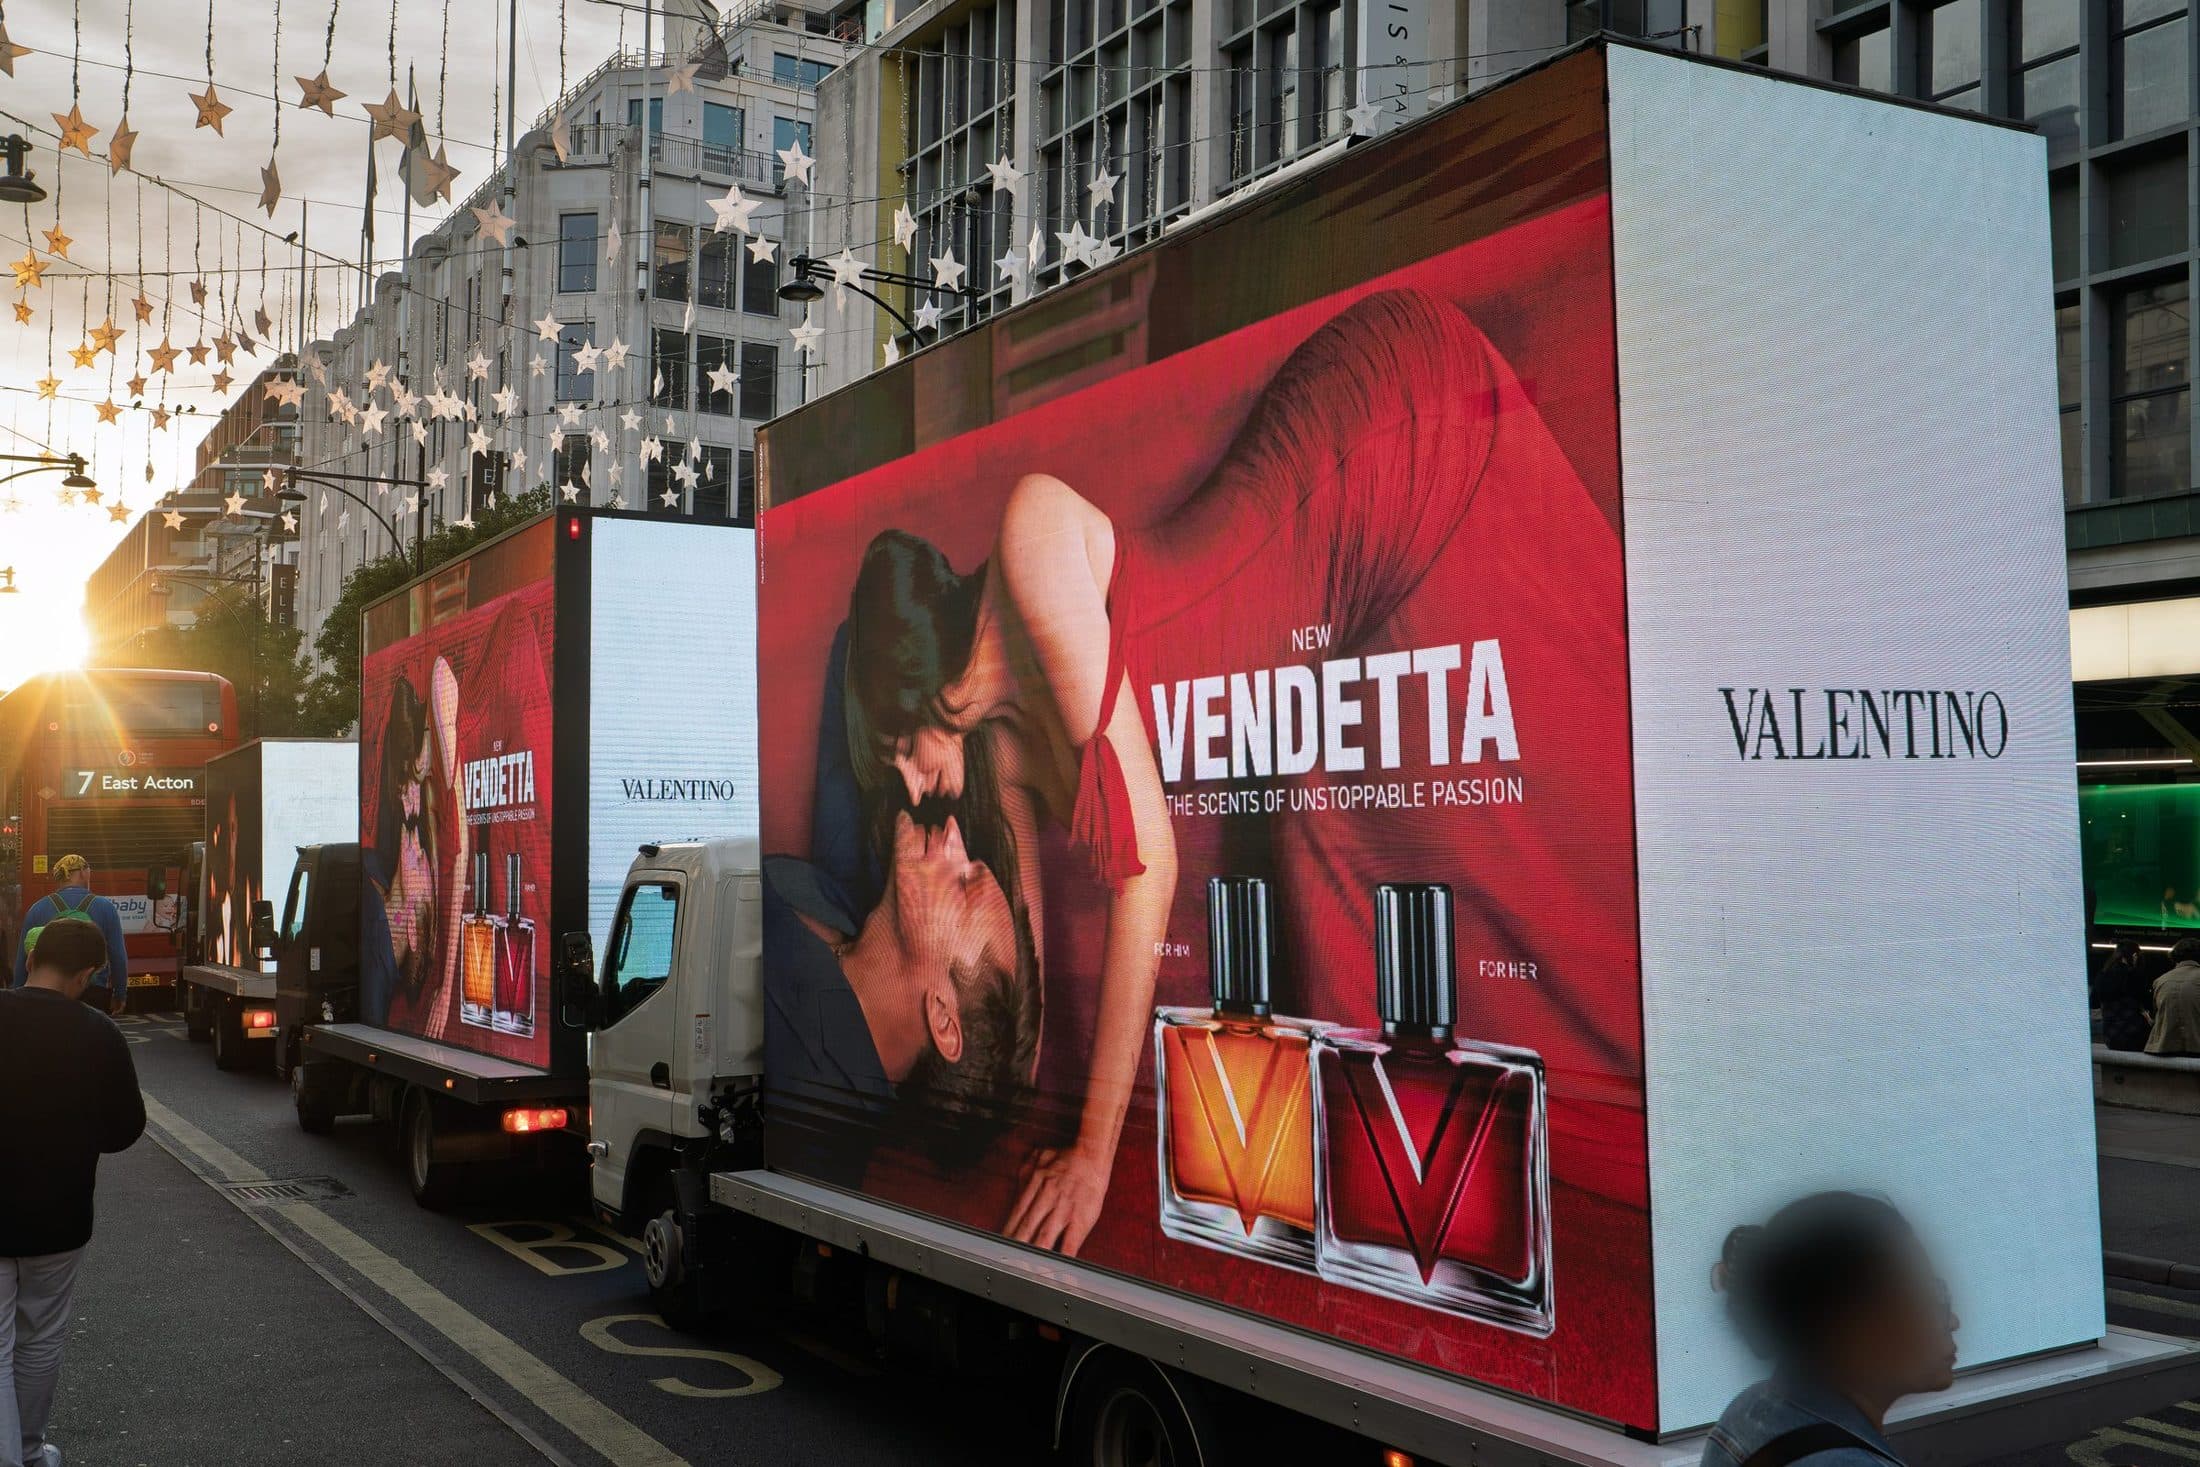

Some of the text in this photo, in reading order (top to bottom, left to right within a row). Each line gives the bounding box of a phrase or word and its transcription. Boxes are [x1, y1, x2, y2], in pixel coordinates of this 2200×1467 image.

[1395, 55, 1407, 67] &
[1292, 624, 1331, 651] NEW
[1151, 638, 1520, 783] VENDETTA
[1718, 688, 2008, 761] VALENTINO
[78, 771, 193, 795] 7 East Acton
[464, 750, 535, 810] VENDETTA
[621, 778, 734, 801] VALENTINO
[1166, 777, 1523, 816] THE SCENTS OF UNSTOPPABLE PASSION
[1479, 960, 1538, 980] FOR HER
